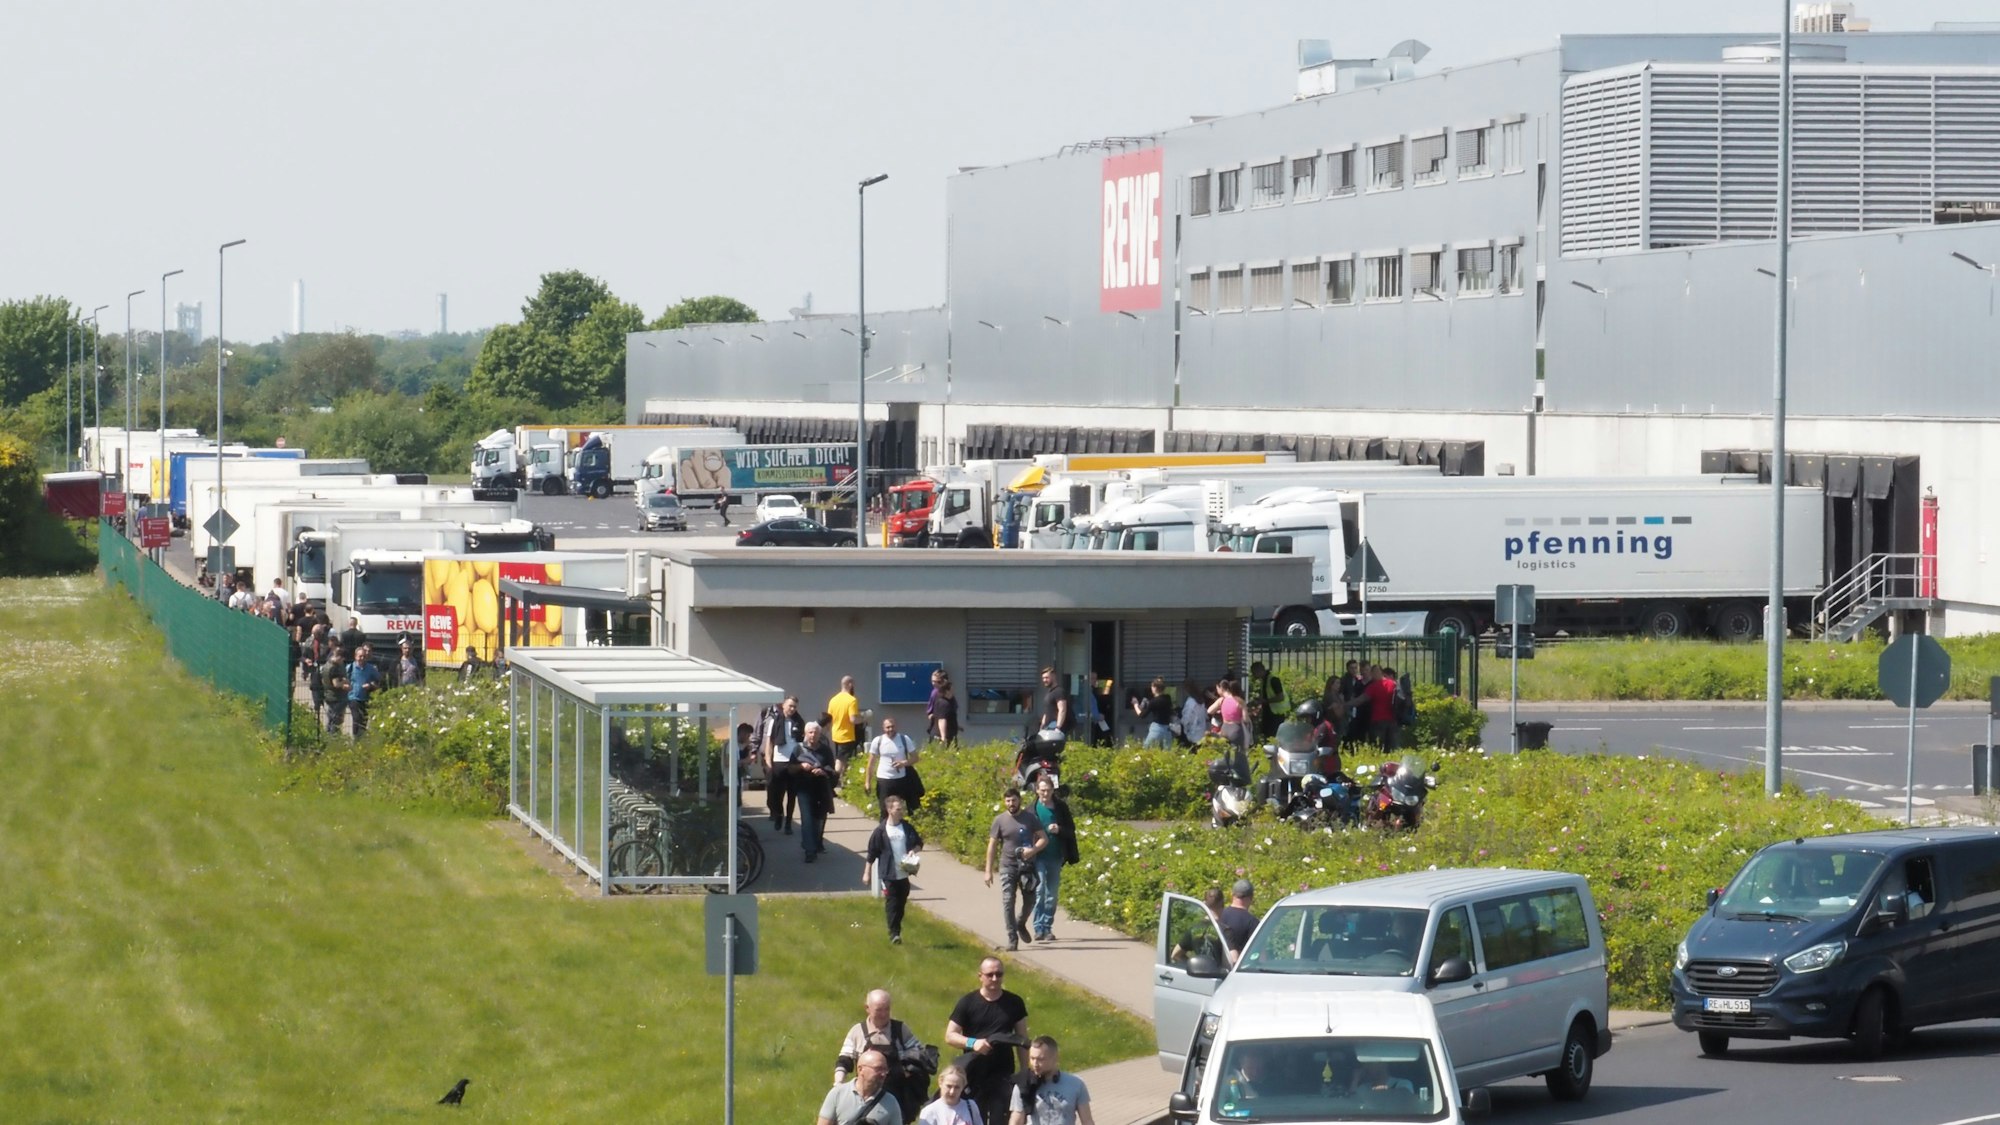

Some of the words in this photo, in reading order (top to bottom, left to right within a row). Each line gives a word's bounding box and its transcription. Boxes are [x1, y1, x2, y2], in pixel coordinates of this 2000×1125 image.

[1103, 171, 1160, 289] REWE
[735, 450, 759, 469] WIR
[764, 448, 810, 467] SUCHEN
[815, 446, 849, 465] DICH!
[1505, 530, 1672, 560] pfenning
[1517, 560, 1576, 571] logistics
[387, 620, 422, 630] REWE
[429, 615, 452, 630] REWE
